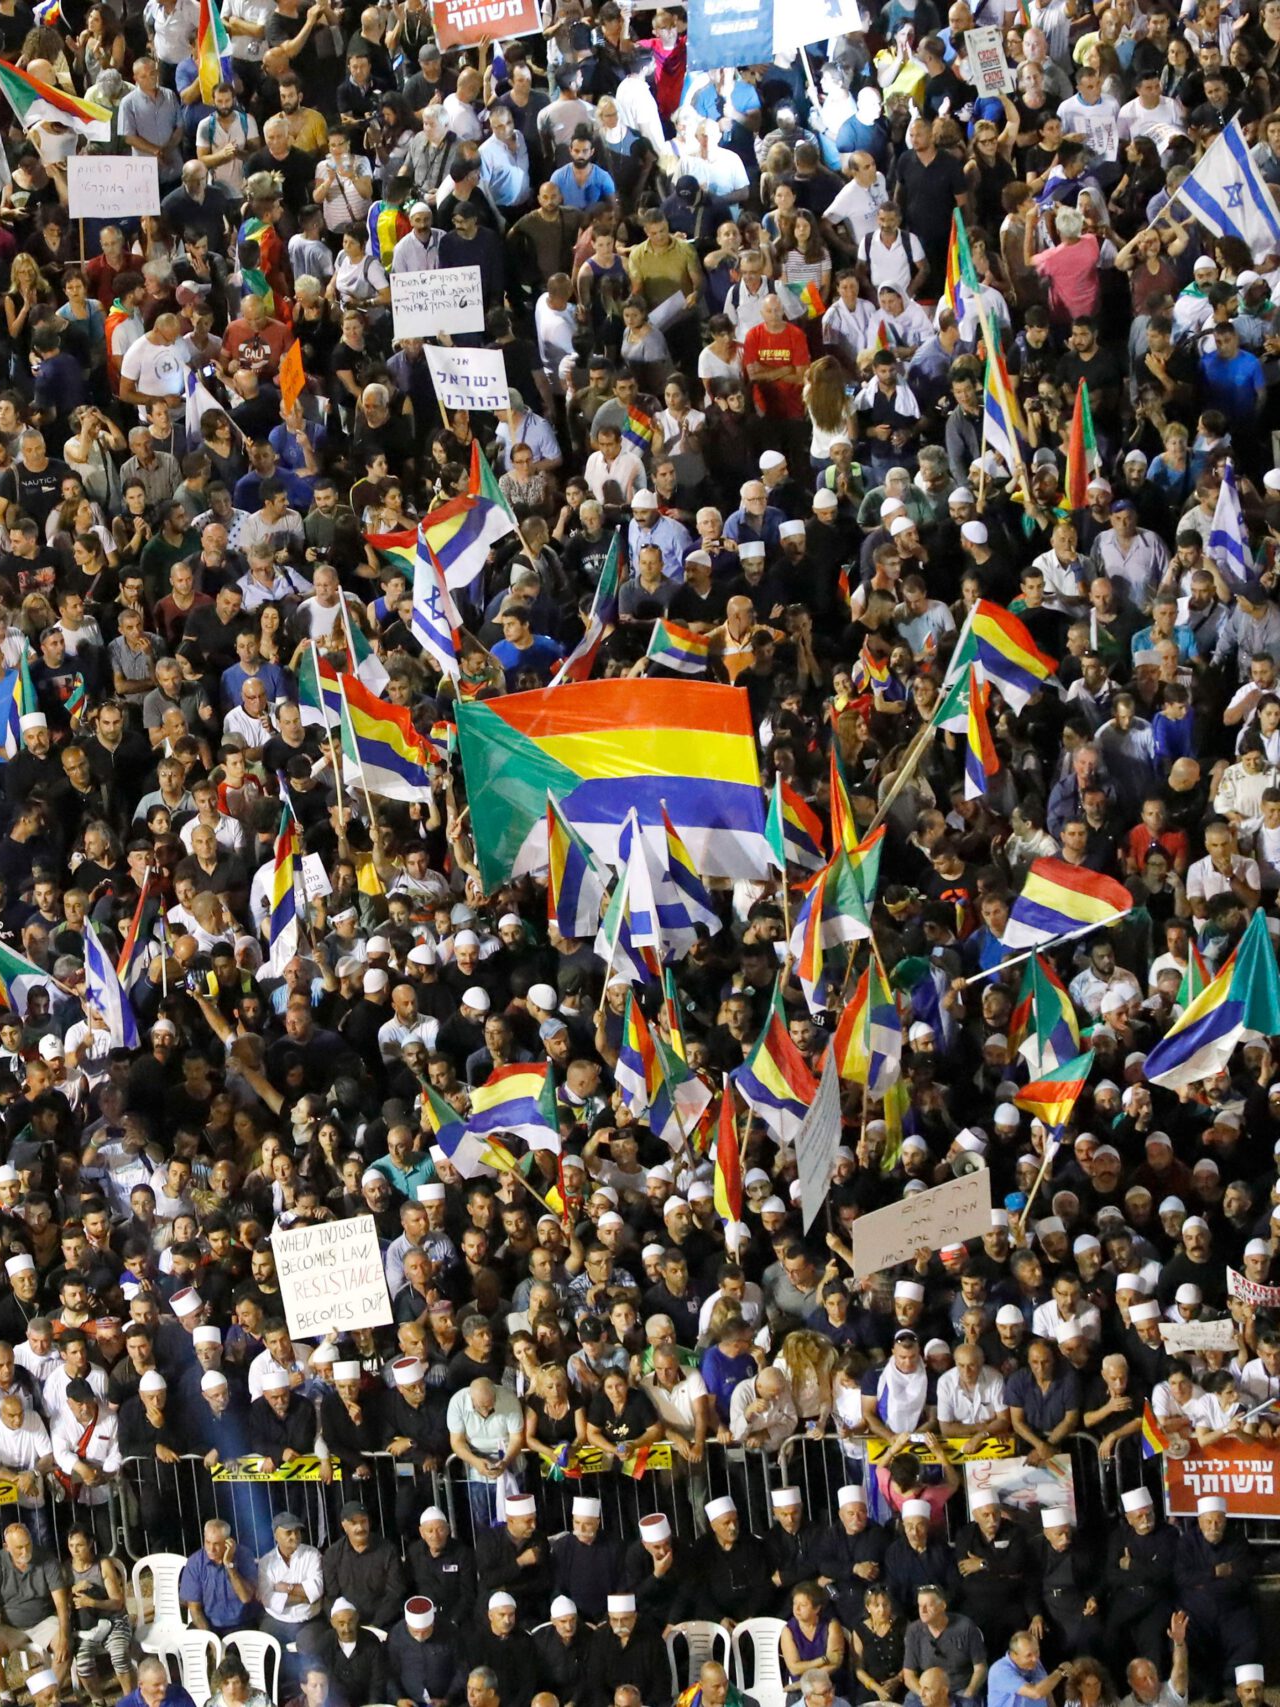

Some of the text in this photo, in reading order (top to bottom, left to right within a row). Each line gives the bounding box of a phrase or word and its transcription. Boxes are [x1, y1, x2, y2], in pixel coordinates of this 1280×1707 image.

[447, 0, 524, 32] משותף
[452, 358, 469, 366] אני
[436, 371, 497, 387] ישראל
[21, 476, 57, 487] NAUTICA
[277, 1218, 375, 1253] WHEN INJUSTICE
[282, 1242, 374, 1276] BECOMES LAW
[293, 1263, 383, 1302] RESISTANCE
[296, 1291, 386, 1330] BECOMES DUTY
[1183, 1458, 1274, 1473] עתיד ילדינו
[1183, 1474, 1274, 1496] משותף
